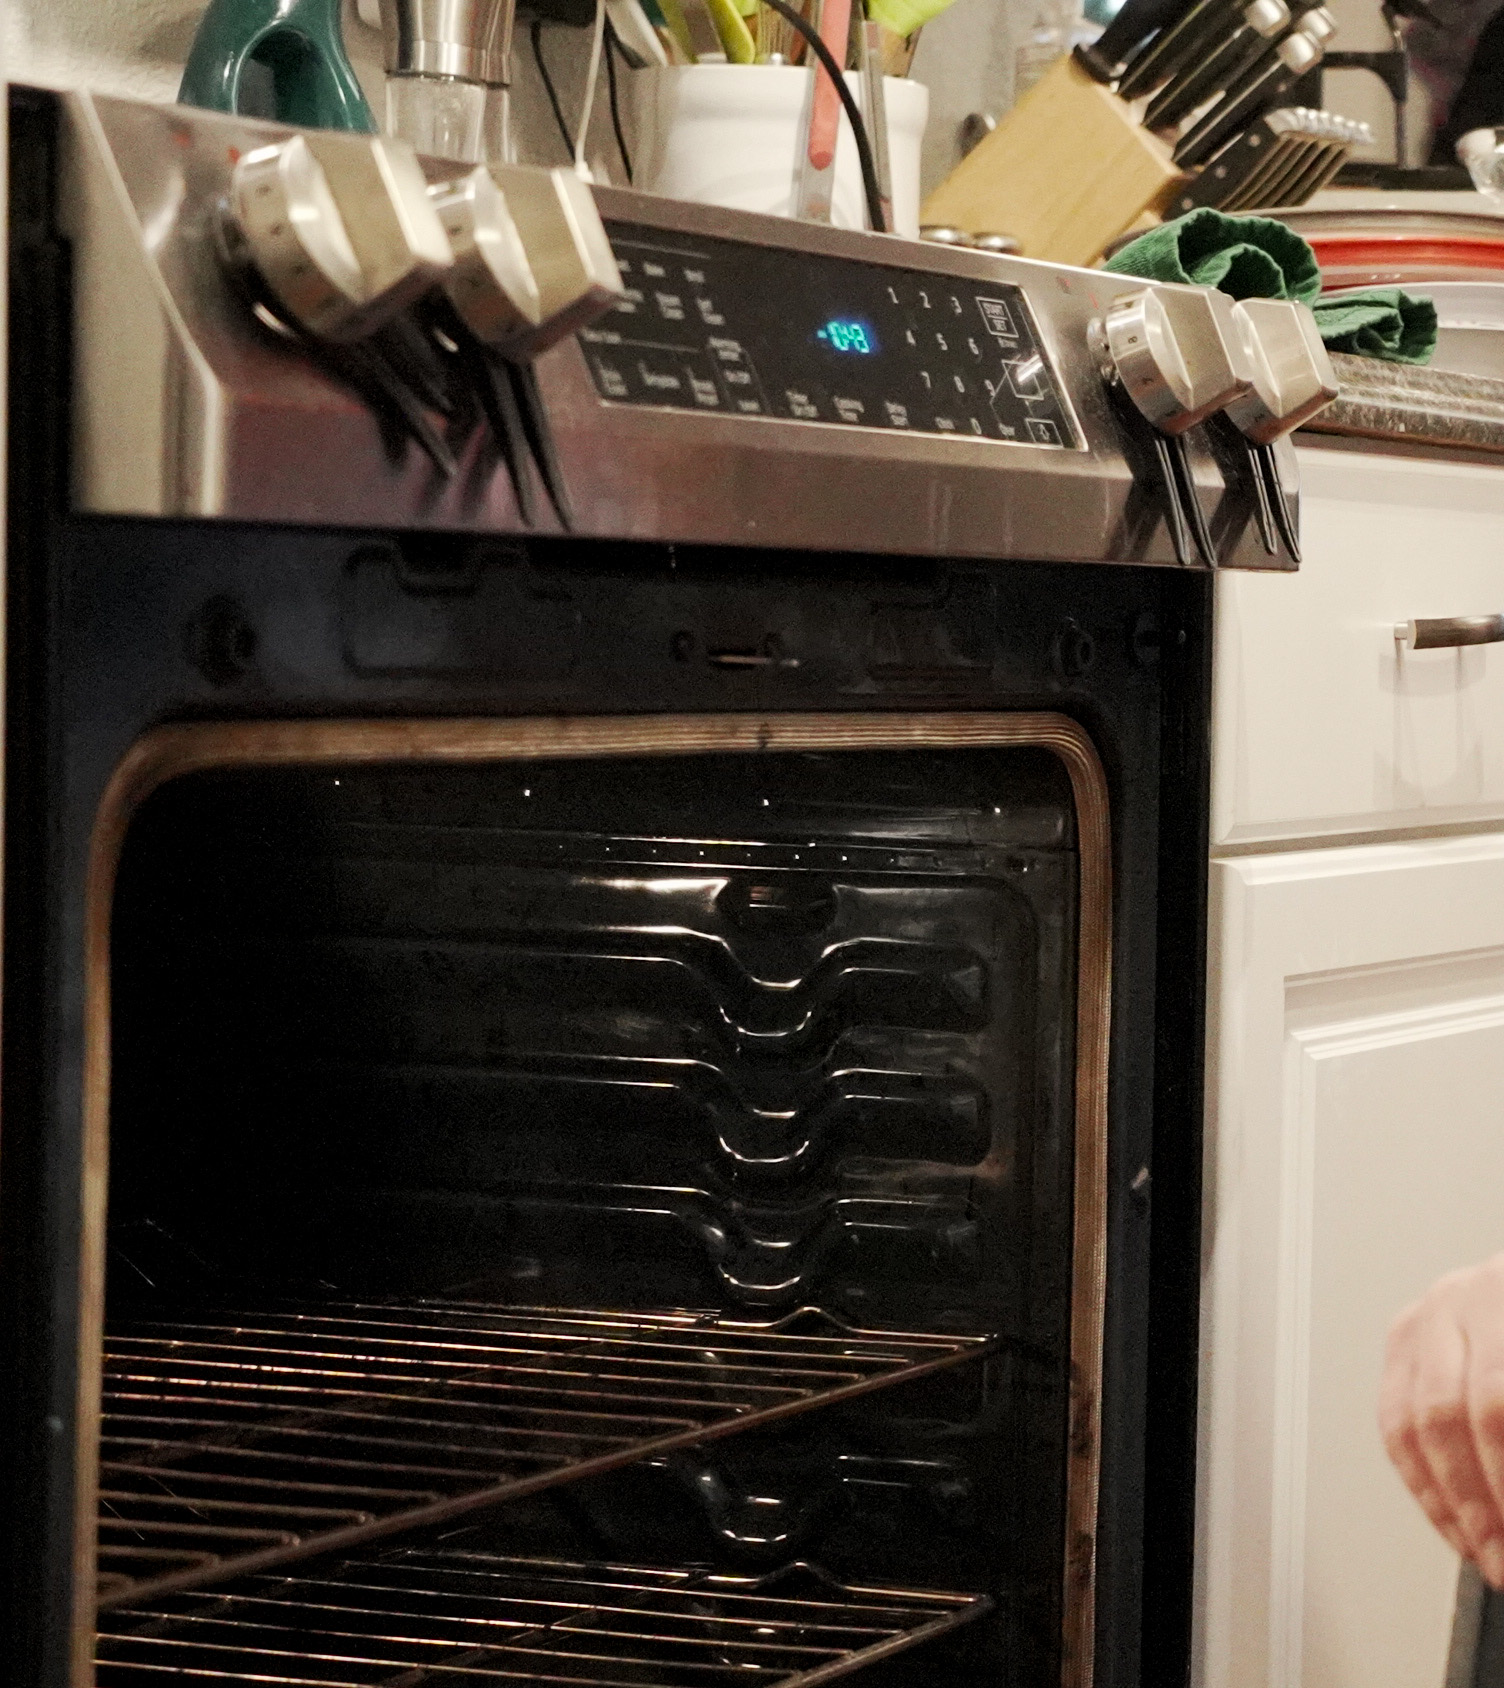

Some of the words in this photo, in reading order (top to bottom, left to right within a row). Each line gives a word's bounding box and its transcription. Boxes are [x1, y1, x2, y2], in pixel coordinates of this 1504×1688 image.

[888, 287, 899, 304] 1
[919, 290, 932, 309] 2
[951, 296, 963, 315] 3
[905, 329, 917, 346] 4
[935, 332, 949, 351] 5
[967, 337, 980, 355] 6
[920, 370, 932, 389] 7
[953, 375, 966, 393] 8
[983, 378, 996, 397] 9
[968, 416, 983, 435] 0
